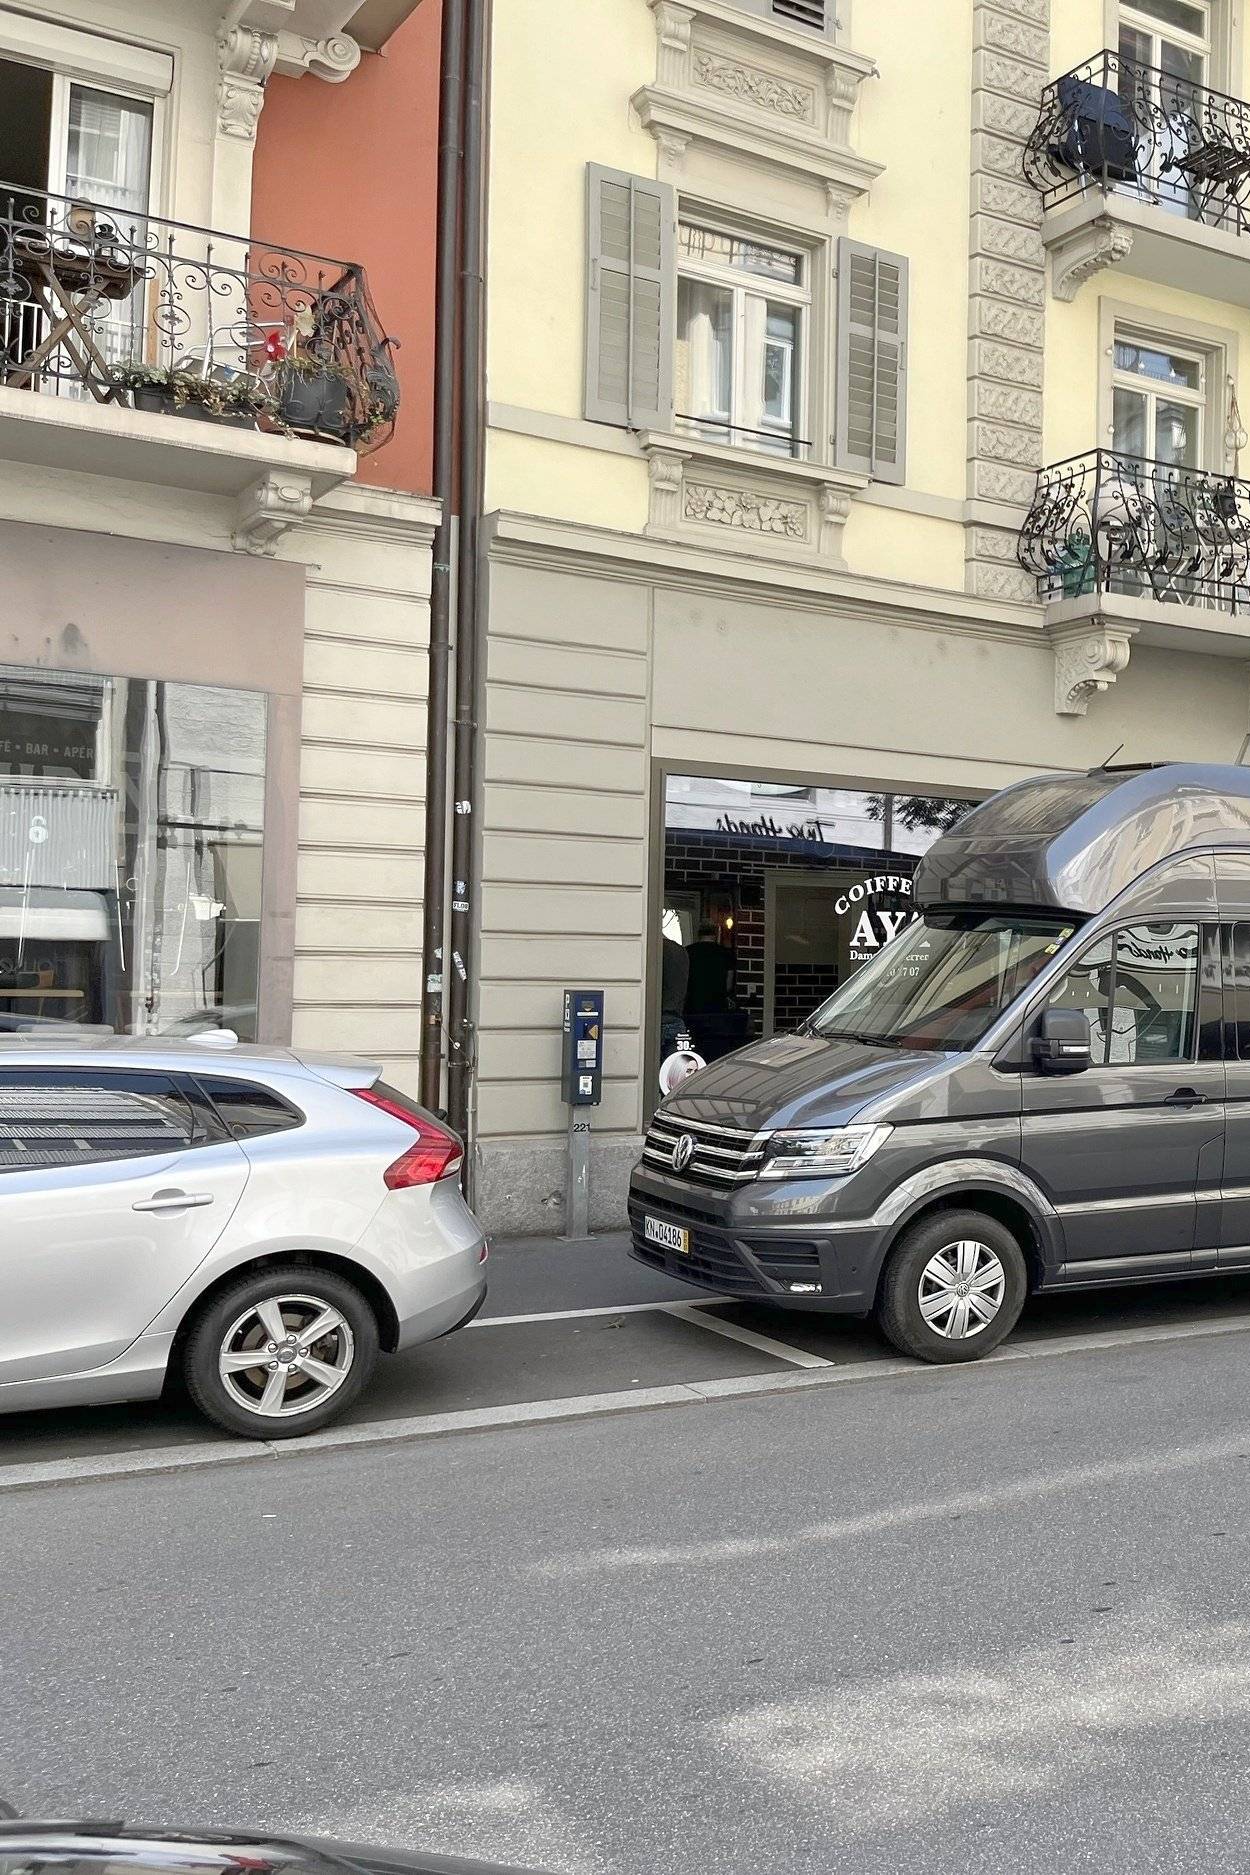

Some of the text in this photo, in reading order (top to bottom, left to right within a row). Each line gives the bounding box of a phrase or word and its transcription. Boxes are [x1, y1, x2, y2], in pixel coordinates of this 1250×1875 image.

[26, 743, 49, 756] BAR
[834, 876, 913, 915] COIFFE
[909, 967, 920, 977] 07
[676, 1041, 696, 1051] 30.-
[573, 1122, 591, 1133] 221
